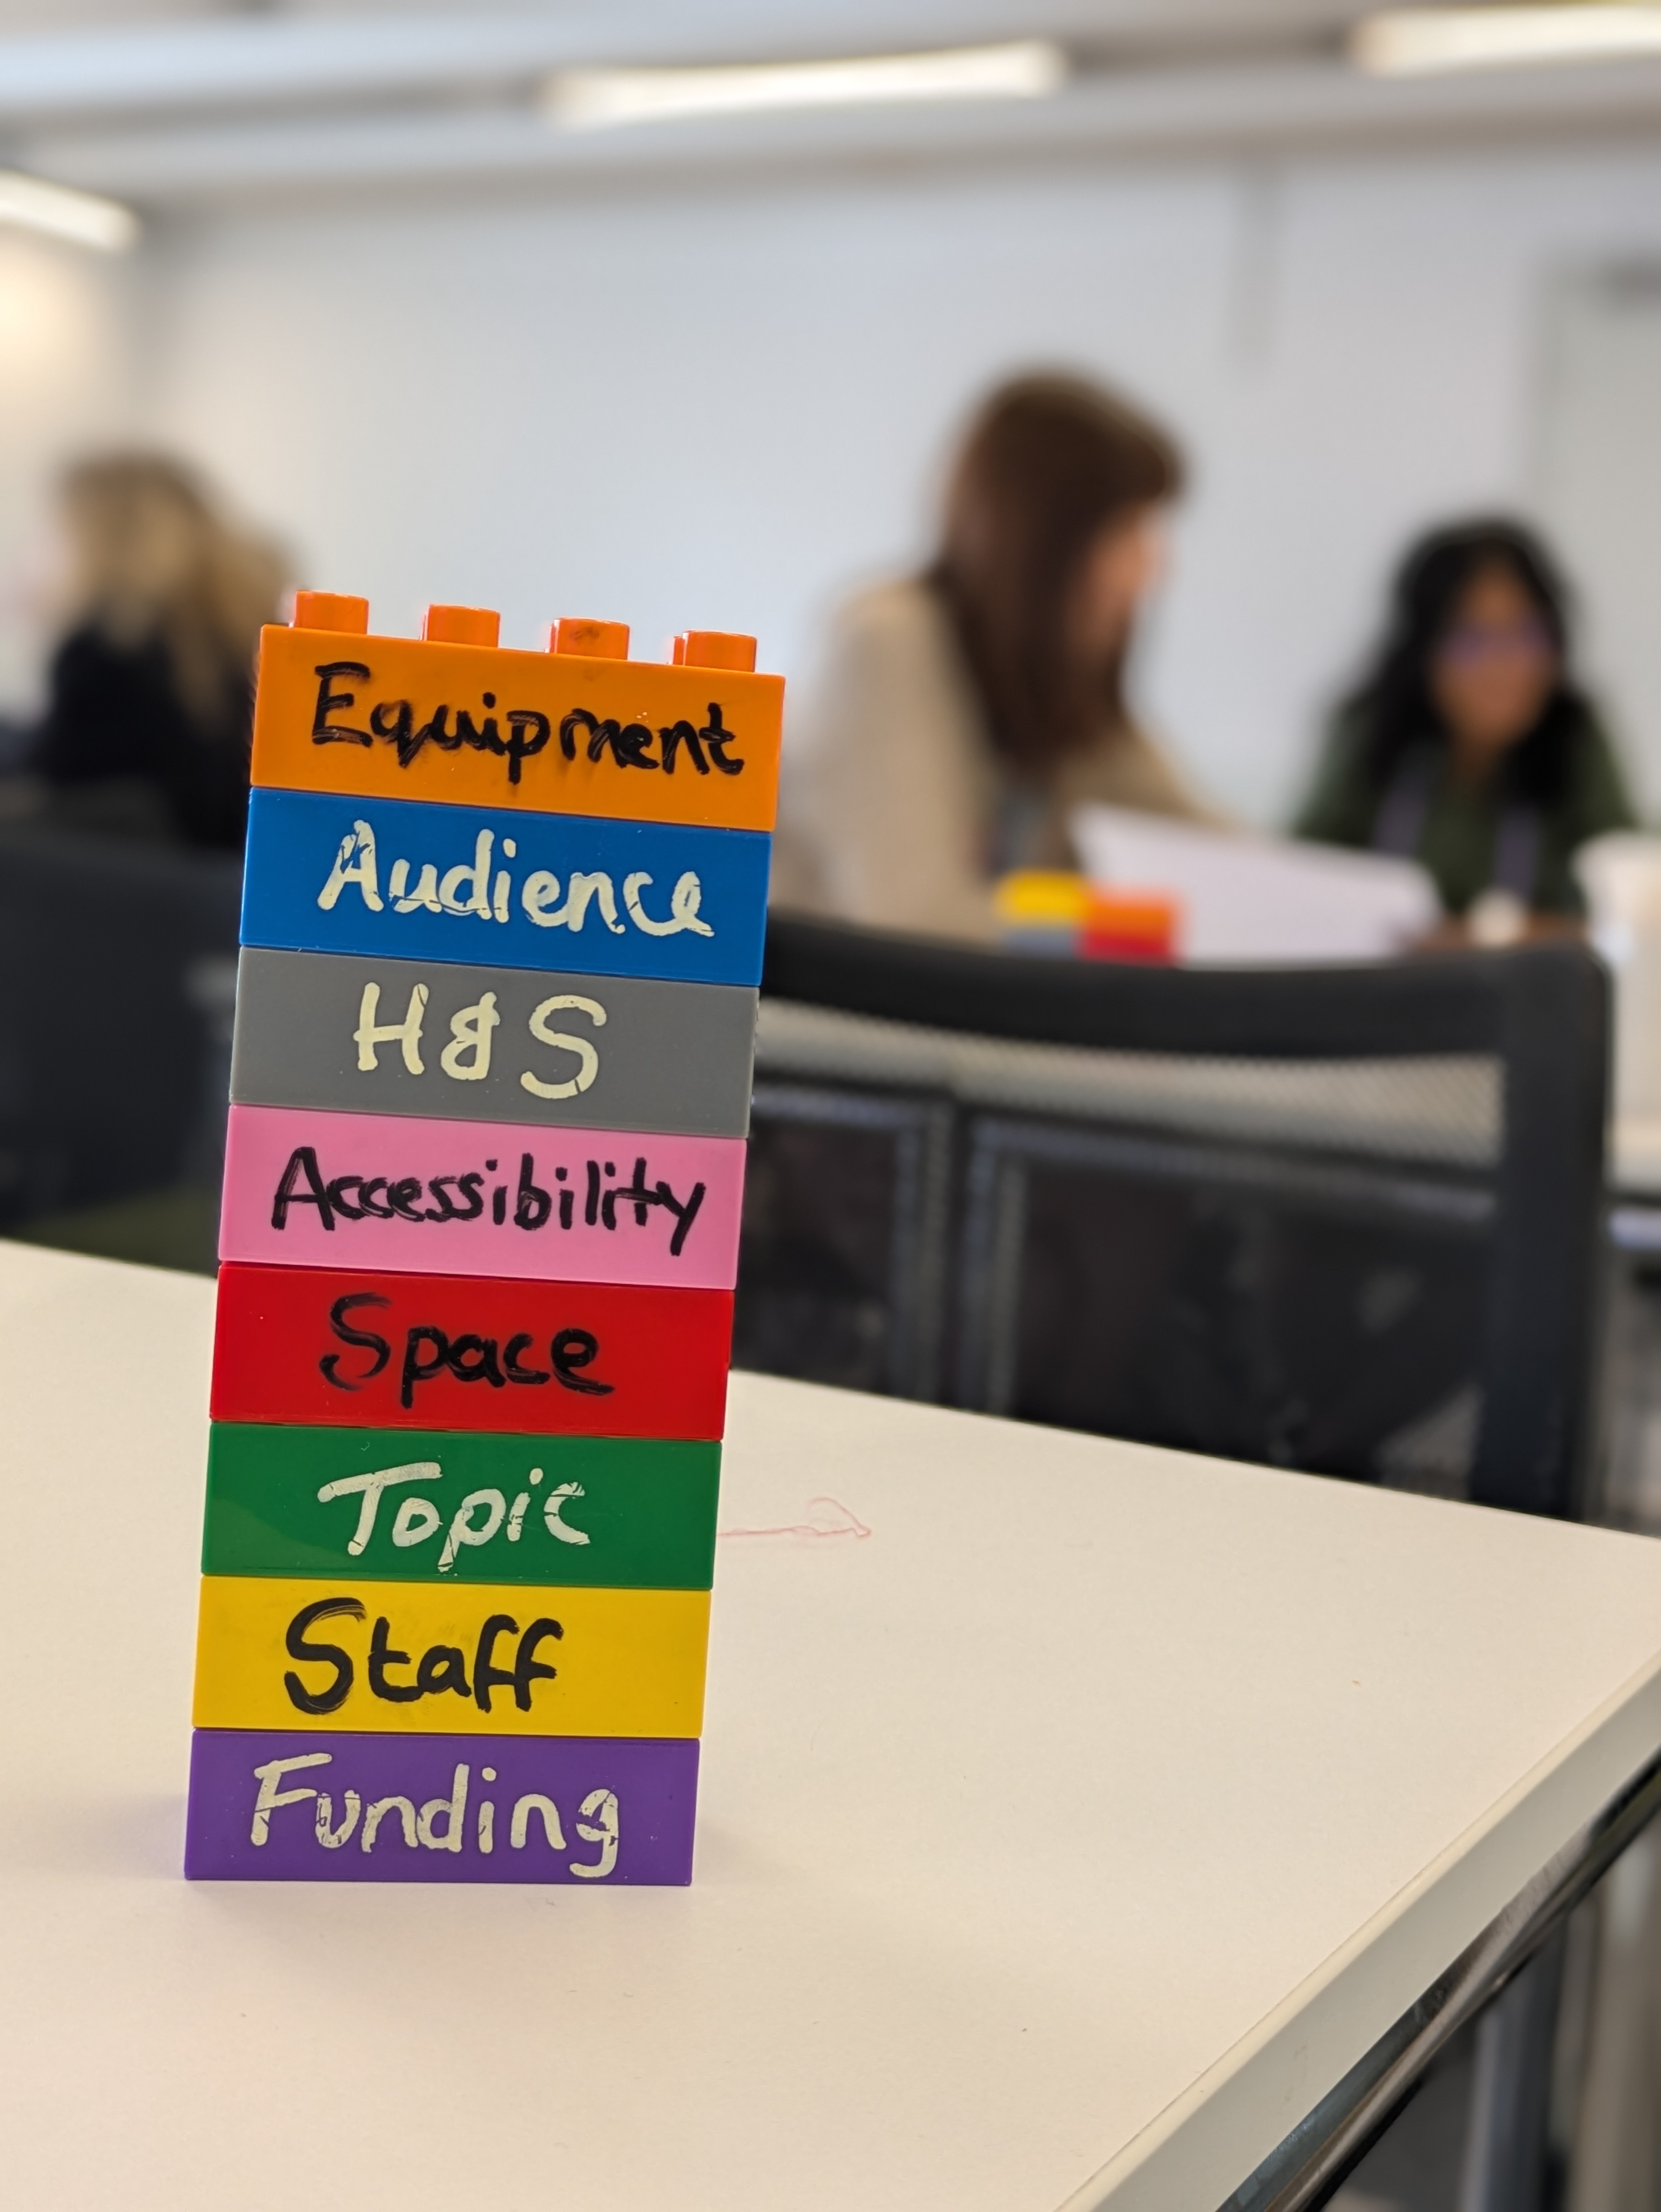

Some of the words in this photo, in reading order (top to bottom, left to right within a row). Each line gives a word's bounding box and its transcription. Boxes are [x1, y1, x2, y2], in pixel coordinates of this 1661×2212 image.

[312, 661, 745, 784] Equipment
[317, 819, 715, 938] Audience
[271, 1147, 706, 1257] Accessibility
[319, 1293, 616, 1409] Space
[318, 1461, 591, 1572] Topic
[284, 1597, 564, 1715] Staff
[249, 1752, 620, 1879] Funding
